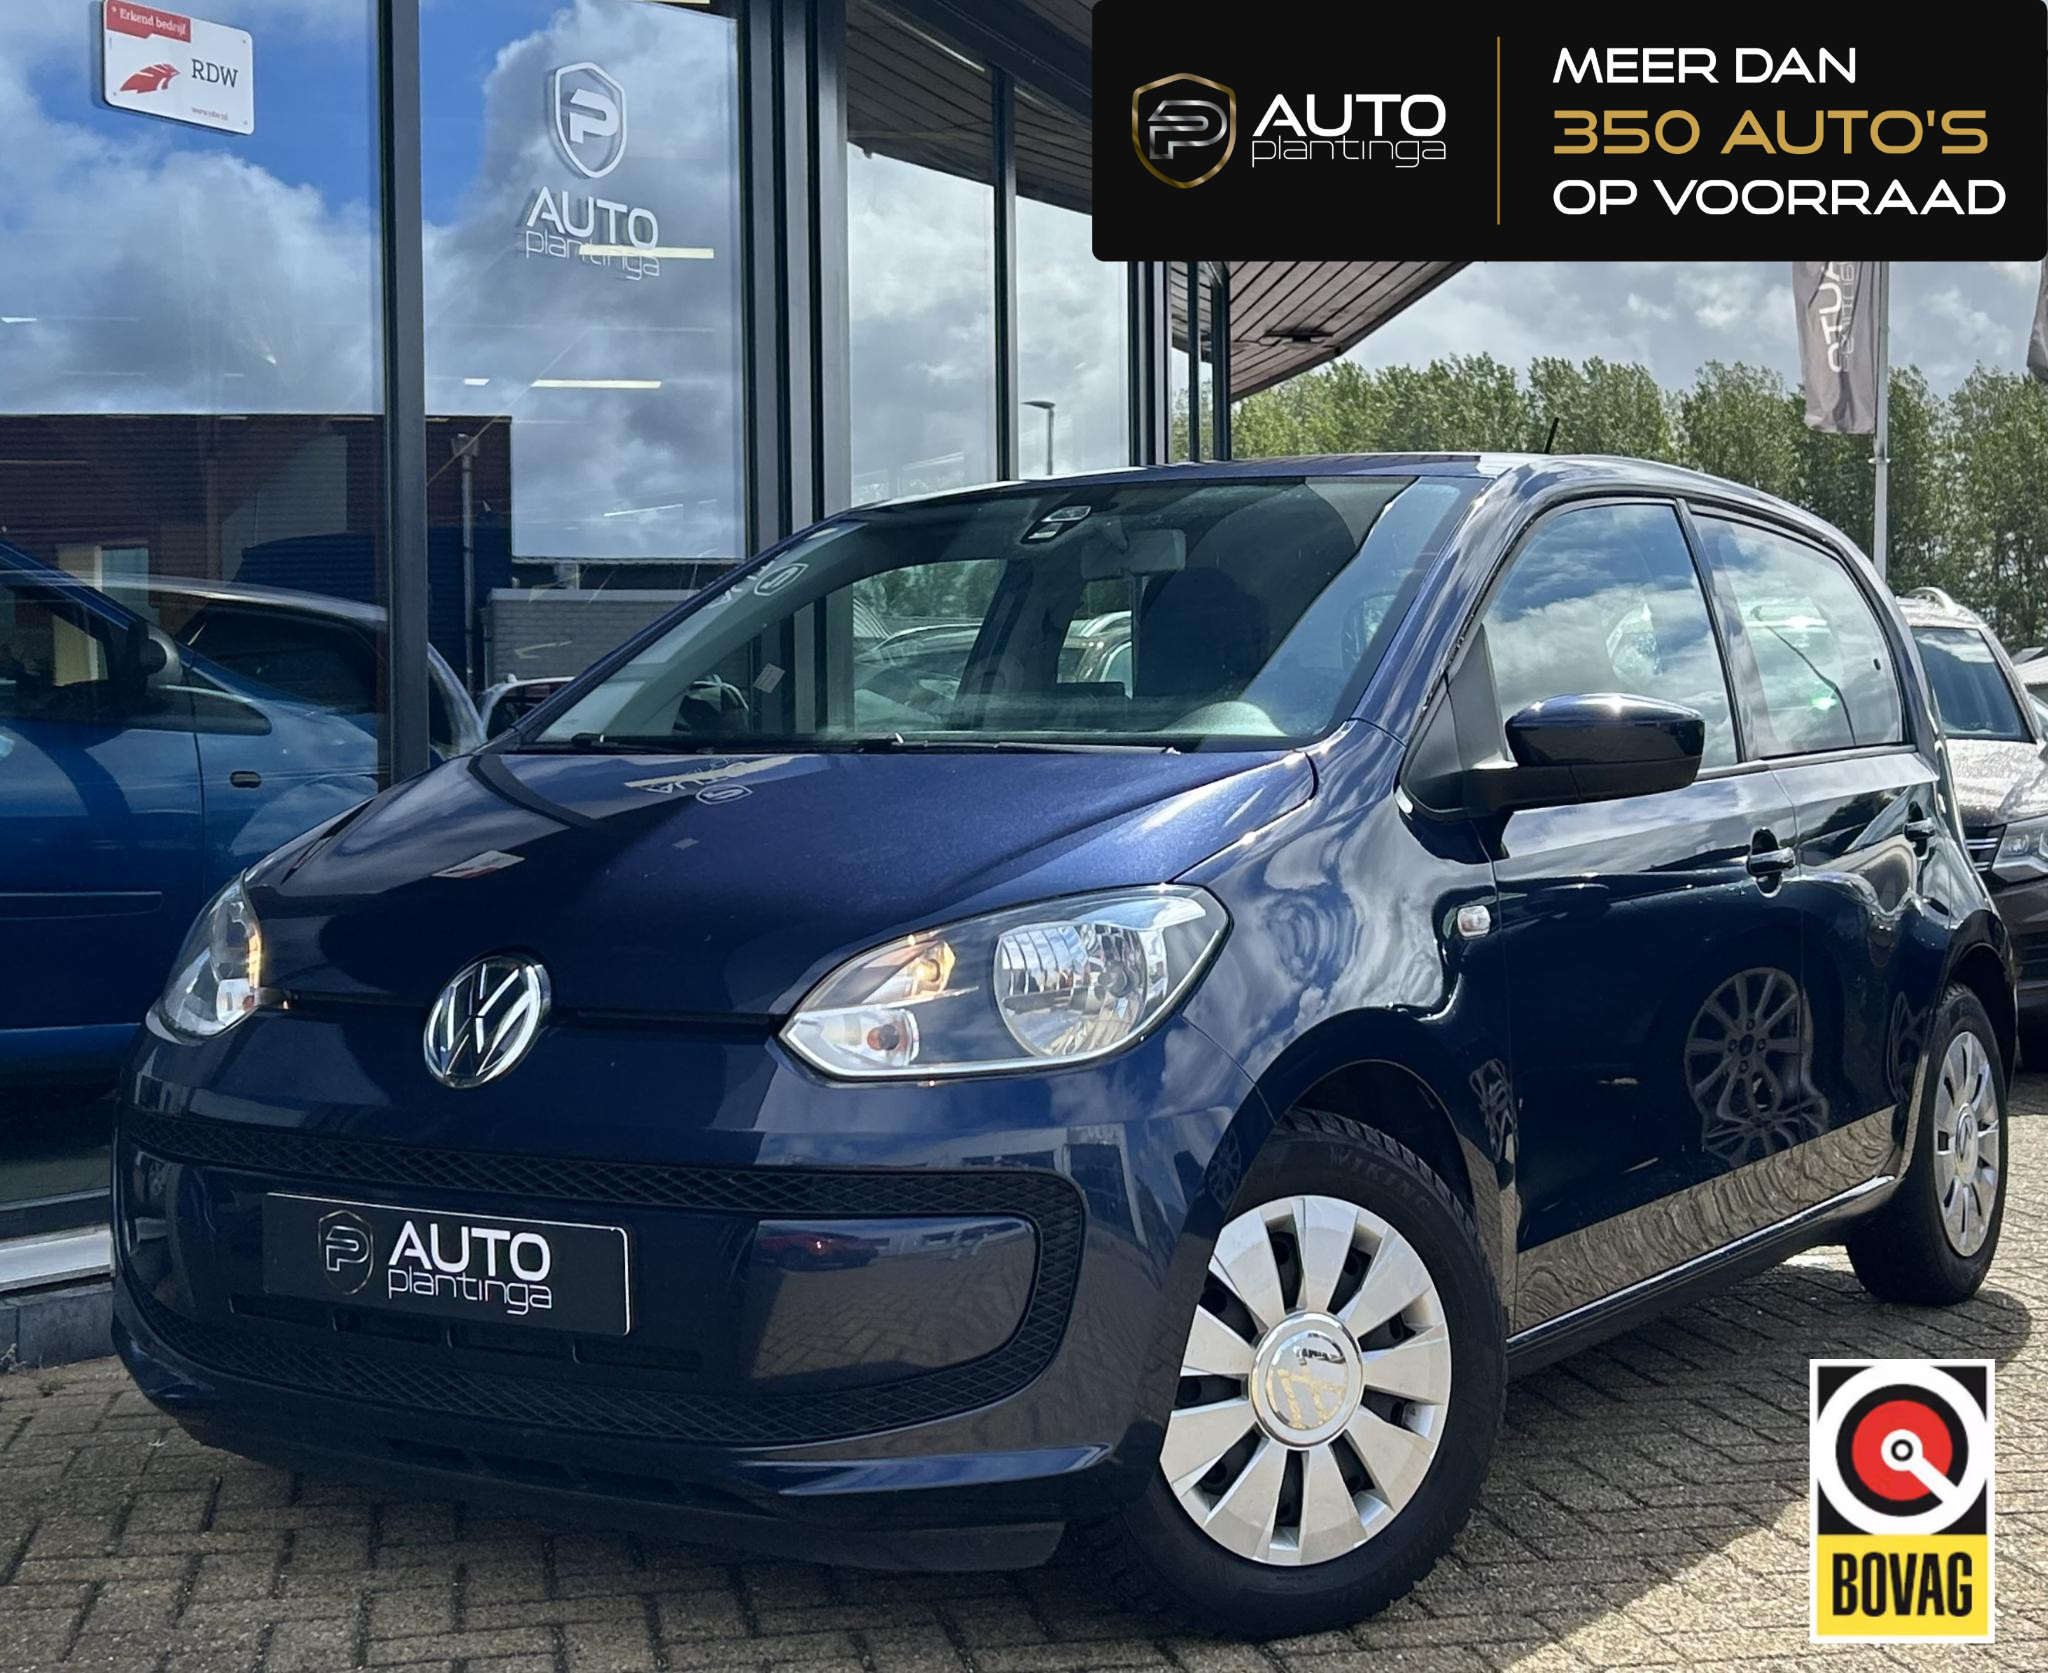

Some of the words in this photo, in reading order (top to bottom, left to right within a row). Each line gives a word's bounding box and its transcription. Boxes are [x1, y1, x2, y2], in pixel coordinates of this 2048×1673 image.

[119, 7, 154, 27] Erkend
[155, 16, 187, 36] bedrijf
[191, 58, 239, 88] RDW
[526, 186, 660, 250] AUTO
[388, 1219, 552, 1283] AUTO
[387, 1265, 553, 1316] plantinga
